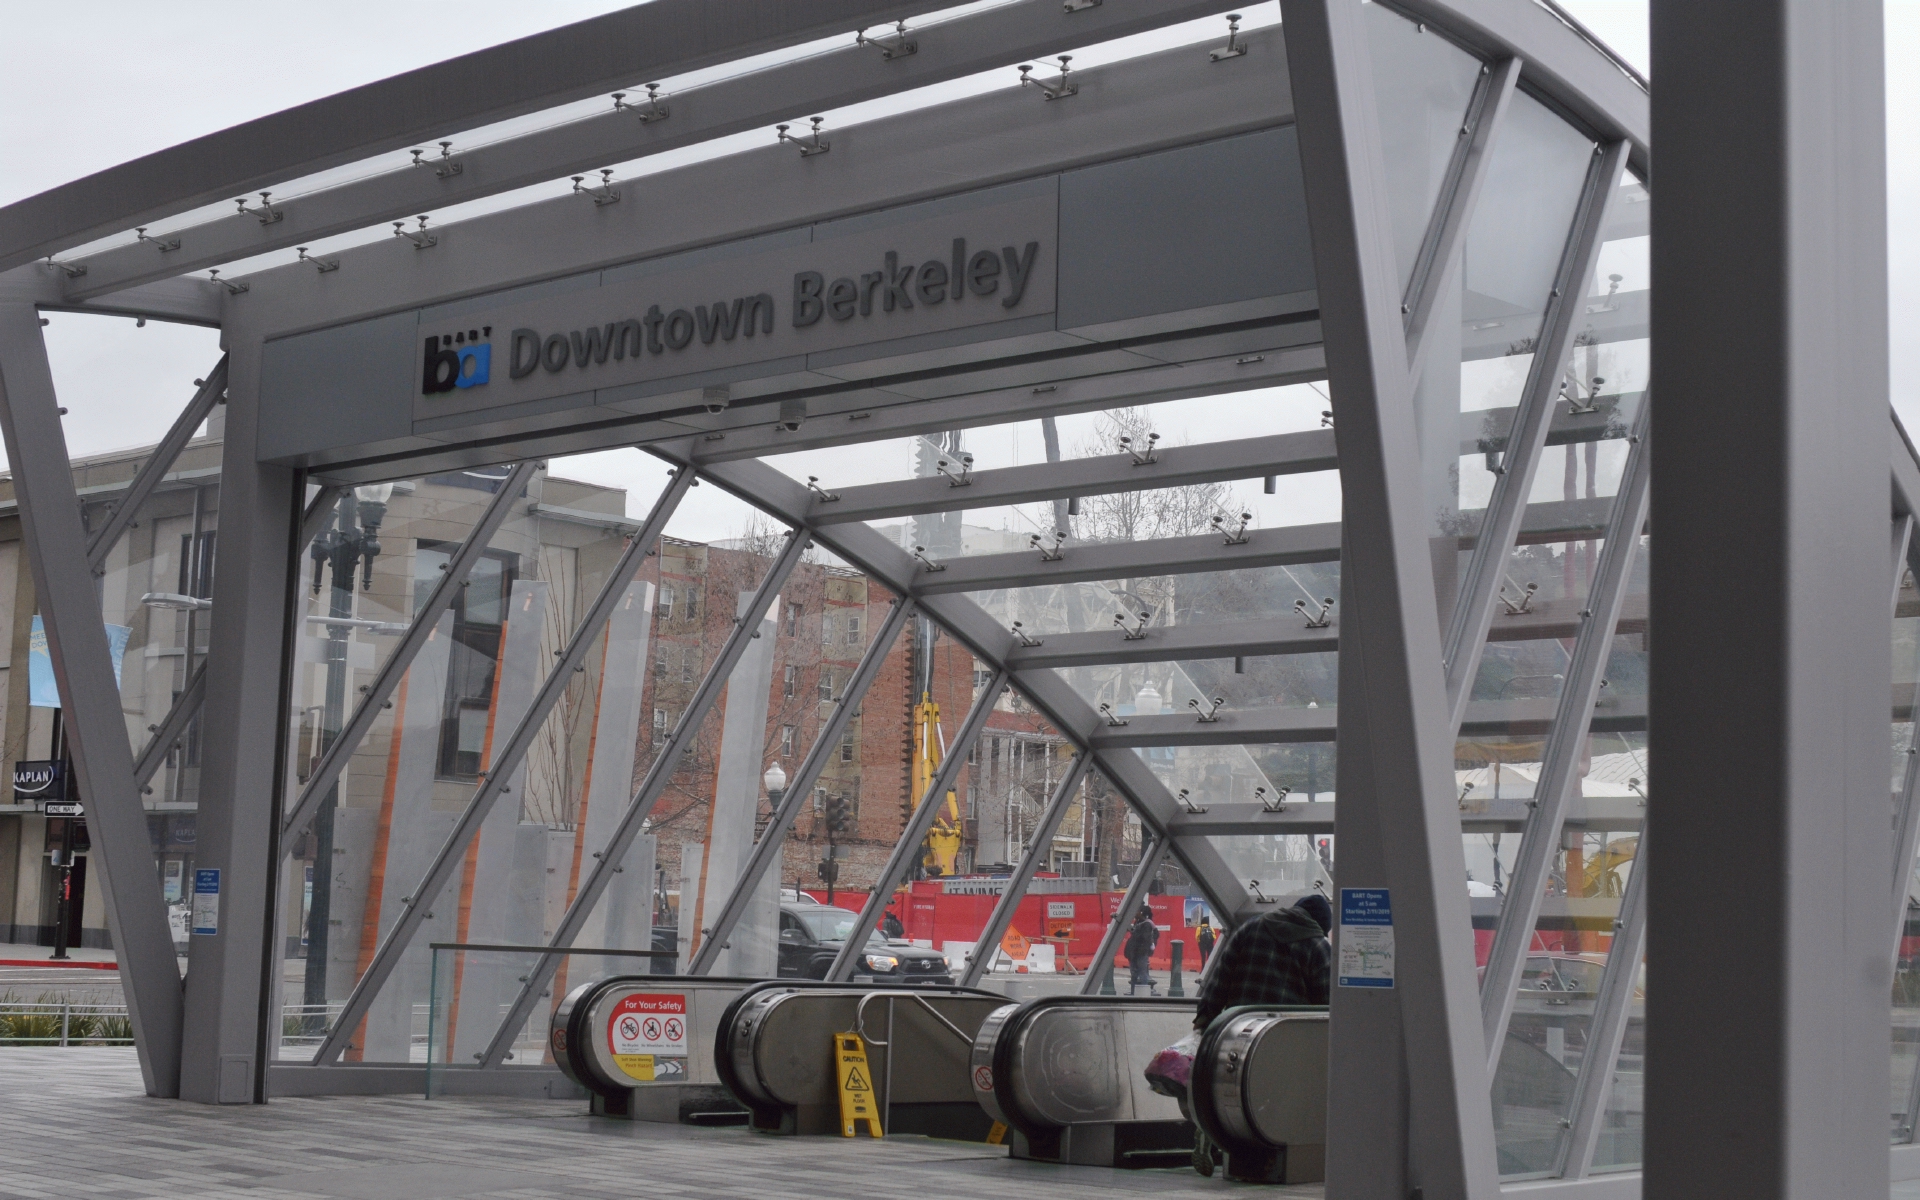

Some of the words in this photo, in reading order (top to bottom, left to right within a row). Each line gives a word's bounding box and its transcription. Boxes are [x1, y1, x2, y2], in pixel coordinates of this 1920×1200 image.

[509, 291, 774, 379] Downtown
[791, 237, 1038, 328] Berkeley
[13, 770, 49, 783] KAPLAN
[48, 805, 61, 813] ONE
[62, 805, 75, 813] WAY
[1345, 908, 1366, 916] Starting
[625, 1000, 637, 1009] For
[639, 1000, 657, 1009] Your
[658, 1001, 682, 1012] Safety
[843, 1055, 865, 1063] CAUTION
